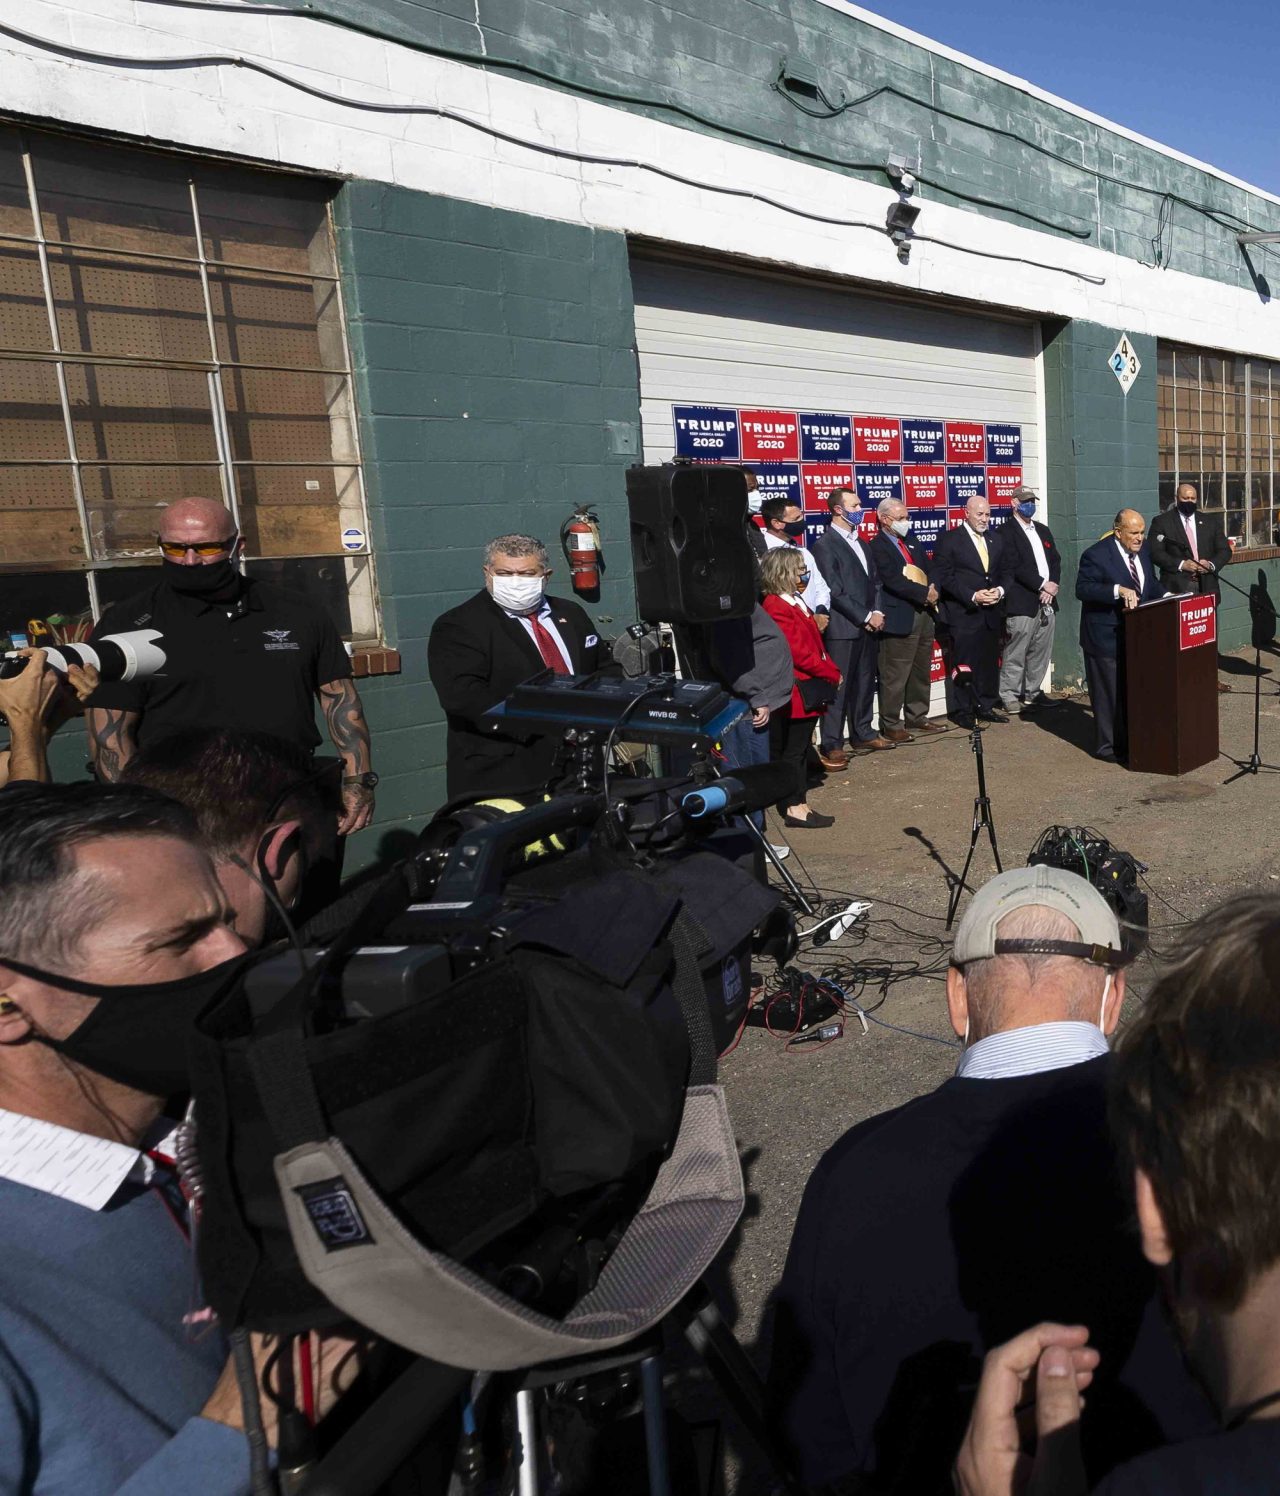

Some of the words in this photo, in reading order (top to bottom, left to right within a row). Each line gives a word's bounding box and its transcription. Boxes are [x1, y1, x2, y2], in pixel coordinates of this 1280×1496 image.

[1121, 340, 1128, 358] 4
[1114, 353, 1122, 371] 2
[1130, 356, 1136, 374] 3
[677, 419, 735, 432] TRUMP
[743, 422, 795, 434] TRUMP
[802, 425, 849, 436] TRUMP
[855, 428, 898, 438] TRUMP
[903, 430, 942, 440] TRUMP
[693, 438, 724, 447] 2020
[948, 434, 982, 443] TRUMP
[987, 434, 1019, 443] TRUMP
[757, 440, 785, 449] 2020
[815, 442, 840, 450] 2020
[867, 444, 890, 452] 2020
[914, 445, 934, 453] 2020
[756, 475, 798, 485] RUMP
[804, 475, 851, 485] TRUMP
[857, 475, 900, 485] TRUMP
[905, 475, 944, 484] TRUMP
[949, 475, 984, 484] TRUMP
[989, 476, 1020, 484] TRUMP
[869, 490, 891, 499] 2020
[915, 490, 936, 498] 2020
[957, 489, 977, 497] 2020
[996, 489, 1014, 497] 2020
[909, 520, 945, 529] TRUMP
[916, 534, 937, 542] 2020
[1182, 606, 1213, 621] TRUMP
[1189, 624, 1207, 635] 2020
[648, 710, 667, 718] WIVB
